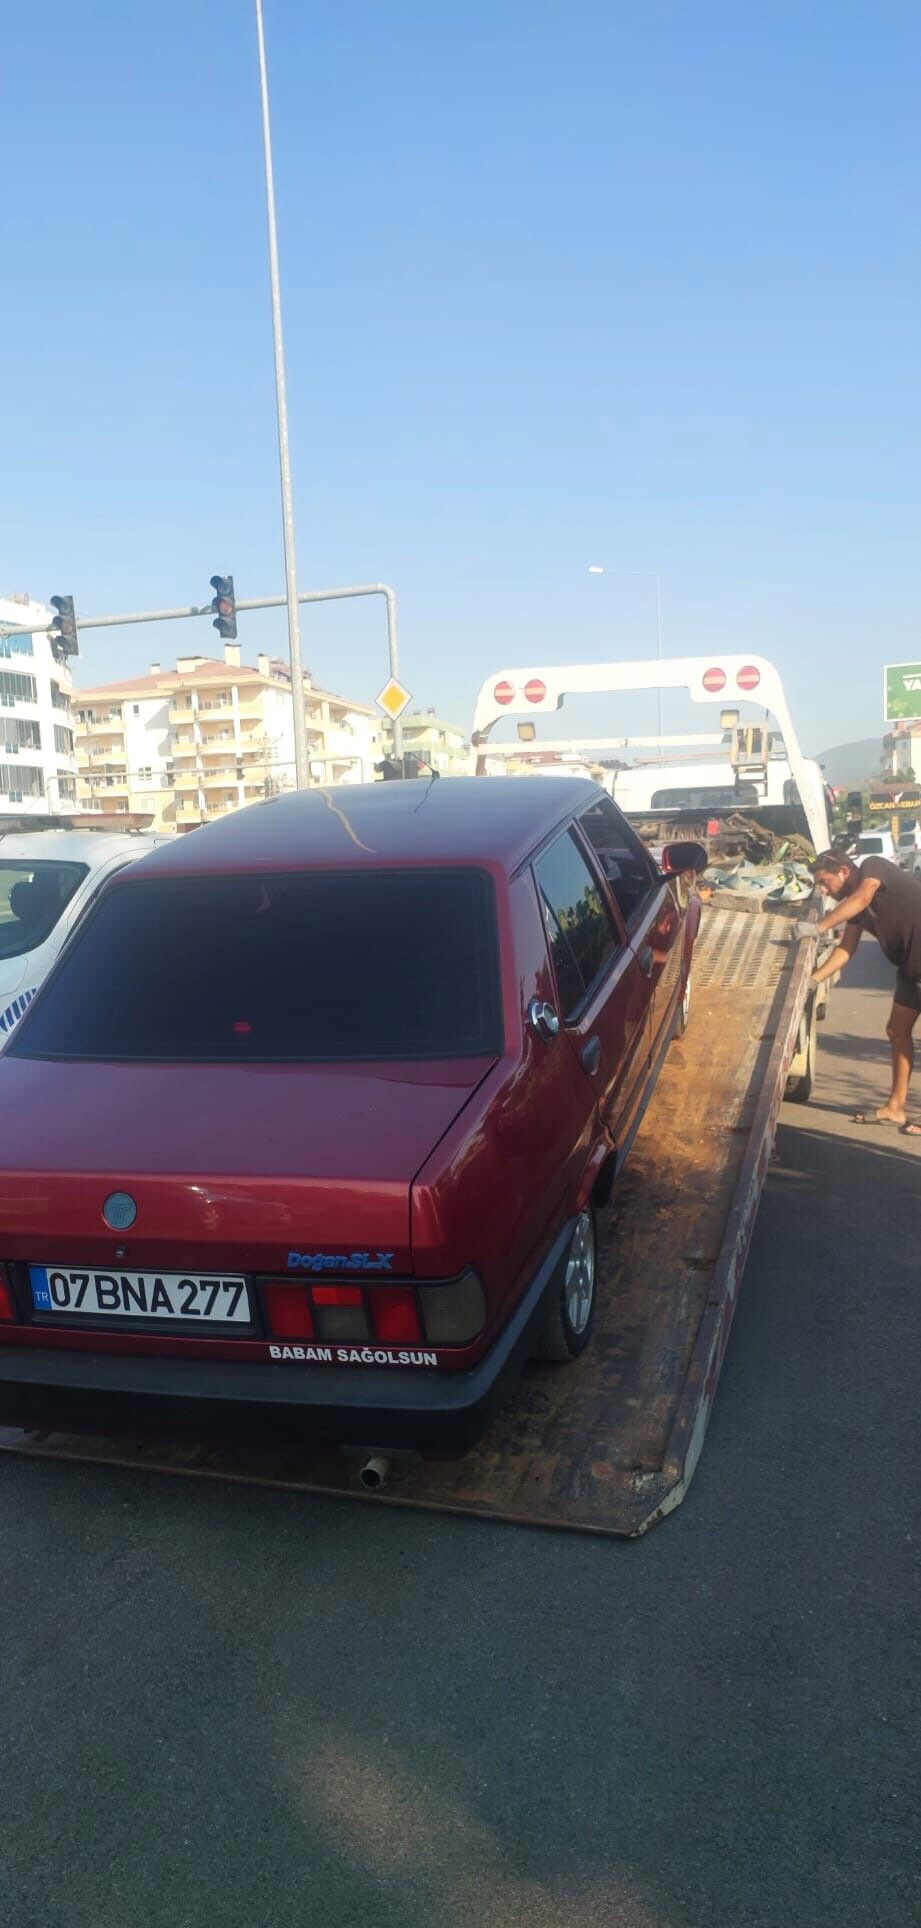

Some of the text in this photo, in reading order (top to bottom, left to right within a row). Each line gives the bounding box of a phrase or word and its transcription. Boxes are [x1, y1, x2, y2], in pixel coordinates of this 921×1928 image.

[35, 1291, 49, 1302] TR
[50, 1272, 244, 1317] 07 BNA 277
[269, 1345, 438, 1365] BABAM SAĞOLSUN
